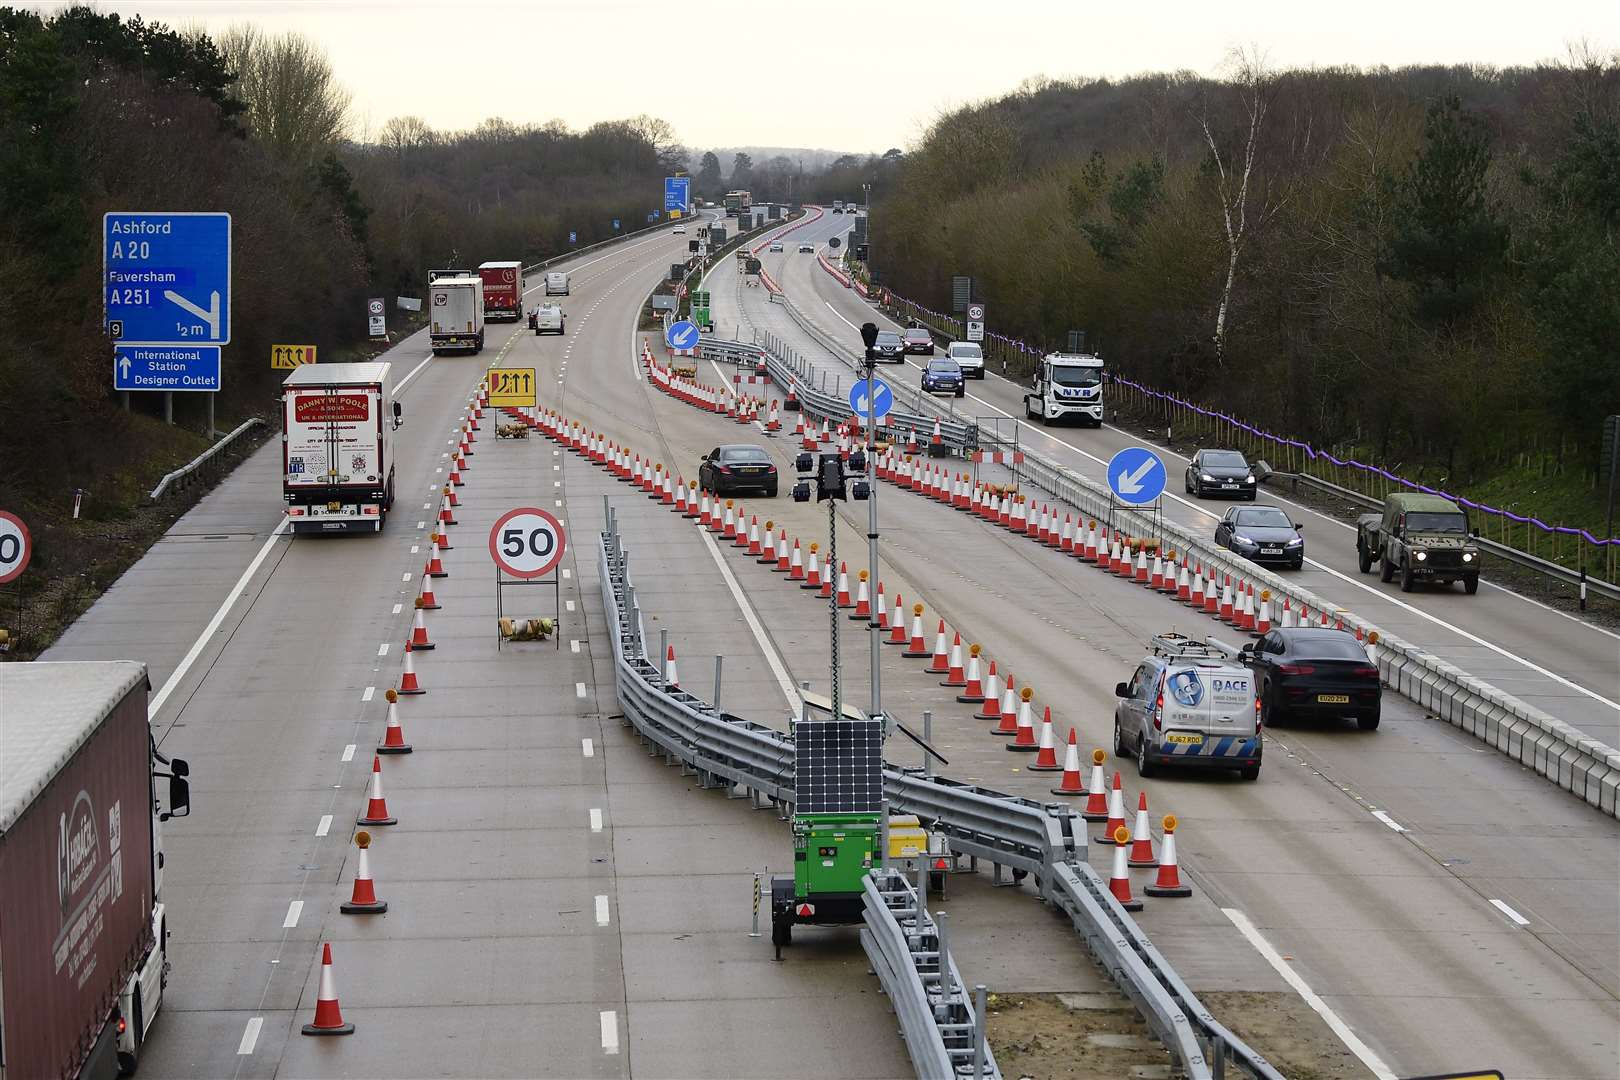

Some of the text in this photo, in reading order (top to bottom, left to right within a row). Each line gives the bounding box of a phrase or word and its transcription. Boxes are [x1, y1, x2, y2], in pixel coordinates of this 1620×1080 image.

[111, 220, 171, 234] Ashford
[109, 271, 176, 282] Faversham
[111, 324, 120, 335] 9
[134, 350, 201, 360] International
[148, 361, 186, 371] Station
[134, 375, 215, 386] Designer Outlet
[1062, 388, 1091, 397] NYR
[297, 398, 326, 412] DANNY
[340, 397, 368, 410] POOLE
[291, 463, 304, 473] TIR
[0, 533, 20, 563] 0
[503, 527, 554, 558] 50
[1224, 680, 1248, 691] ACE
